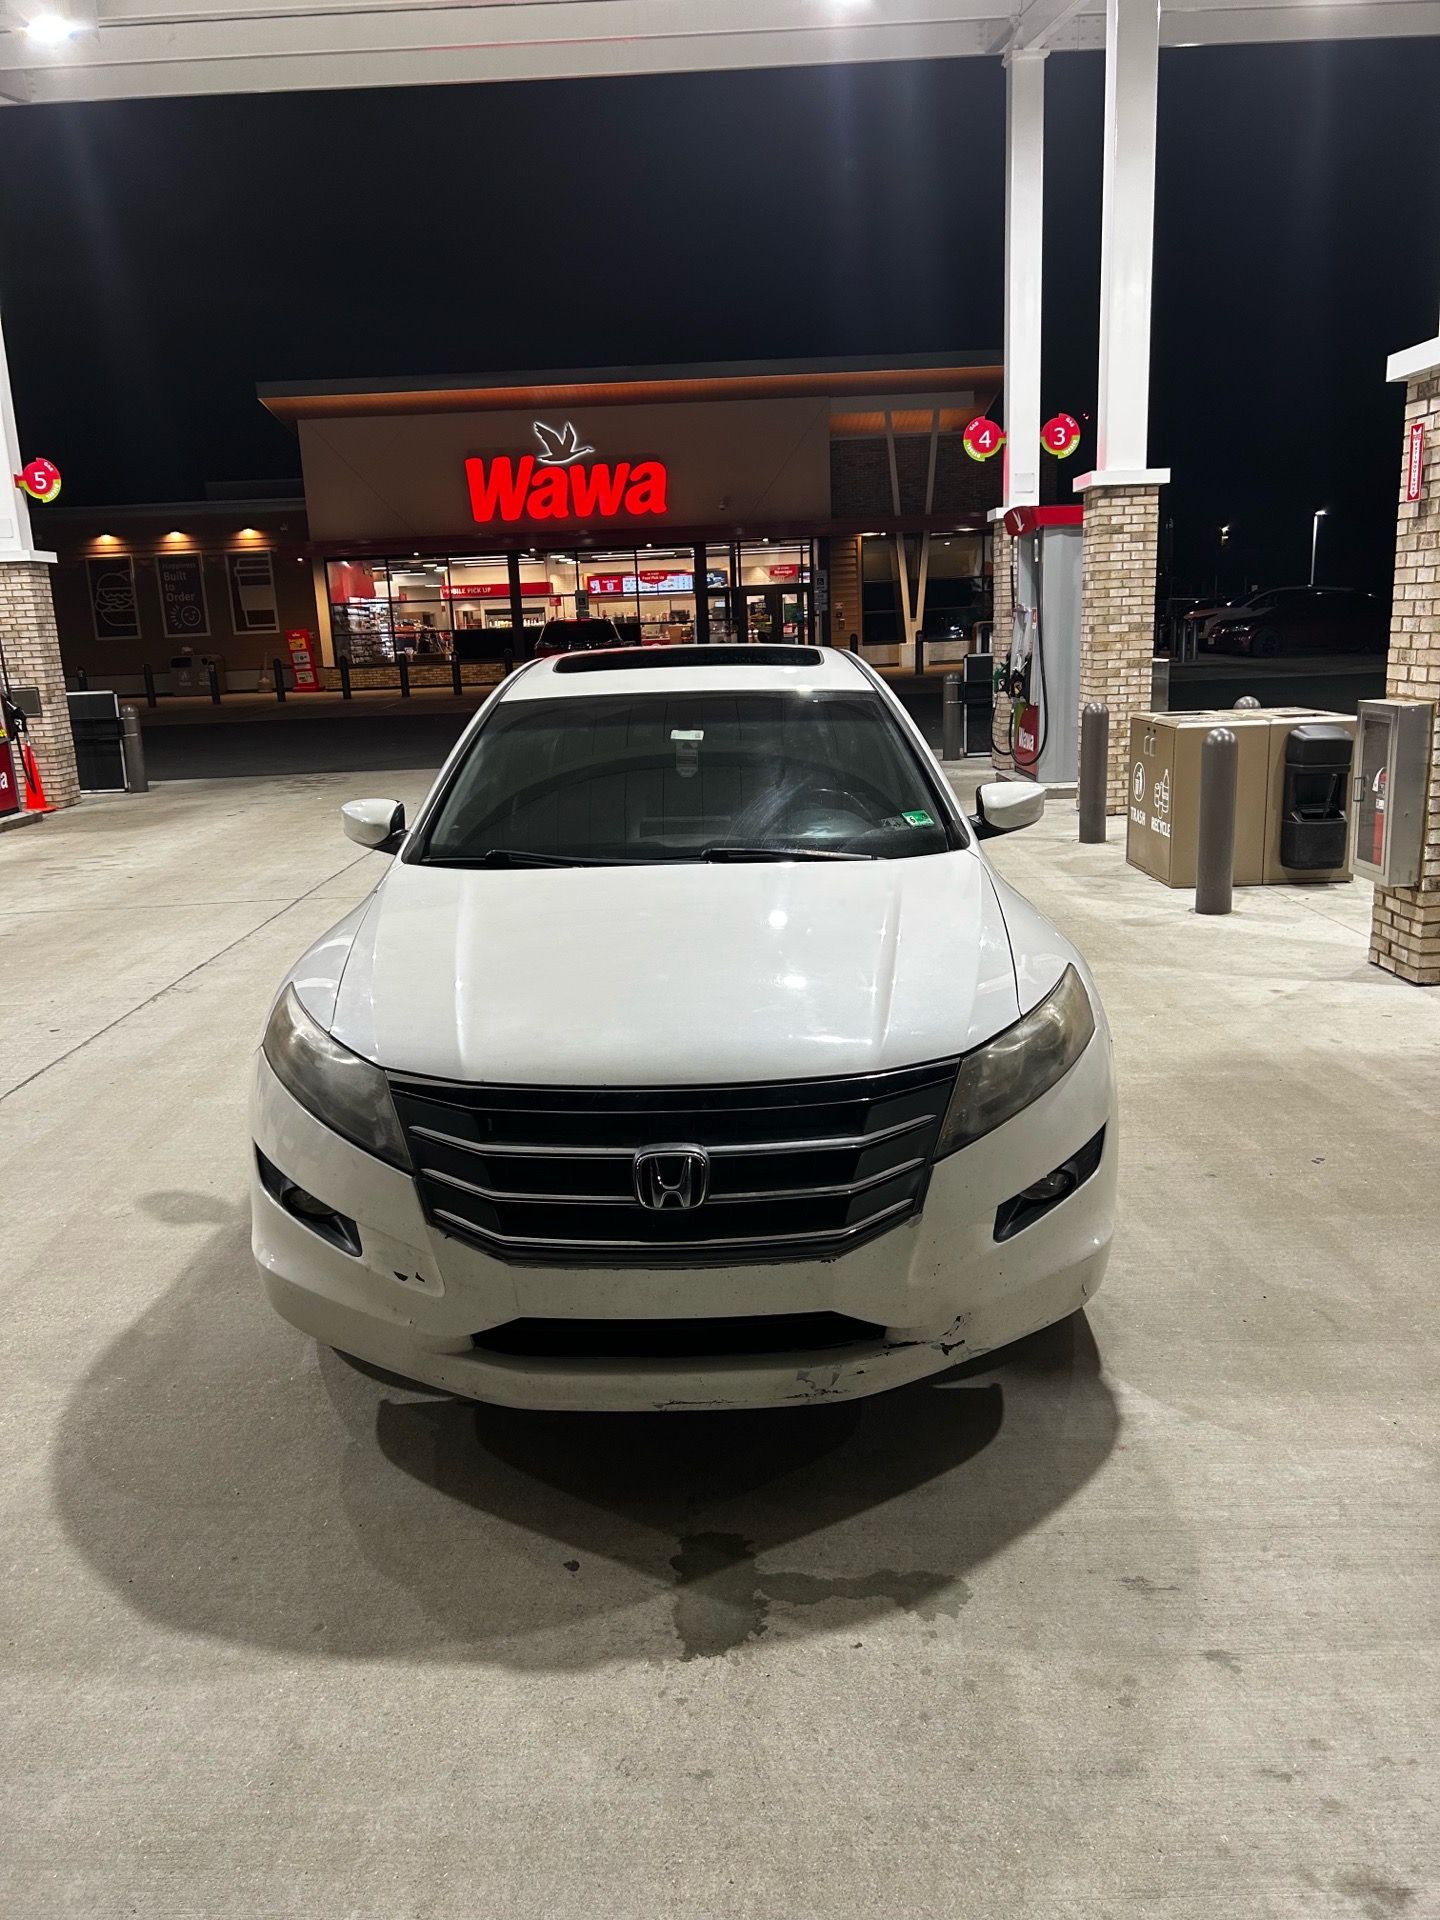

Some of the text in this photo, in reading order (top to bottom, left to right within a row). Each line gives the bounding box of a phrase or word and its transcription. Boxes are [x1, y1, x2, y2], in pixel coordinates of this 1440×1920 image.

[978, 430, 992, 449] 4
[1053, 427, 1066, 446] 3
[34, 471, 47, 490] 5
[464, 454, 668, 523] Wawa
[163, 570, 186, 581] Built
[165, 582, 176, 592] to
[166, 591, 195, 602] Order
[1018, 726, 1035, 752] Wawa
[1130, 806, 1146, 827] TRASH
[1151, 816, 1171, 838] RECYCLE
